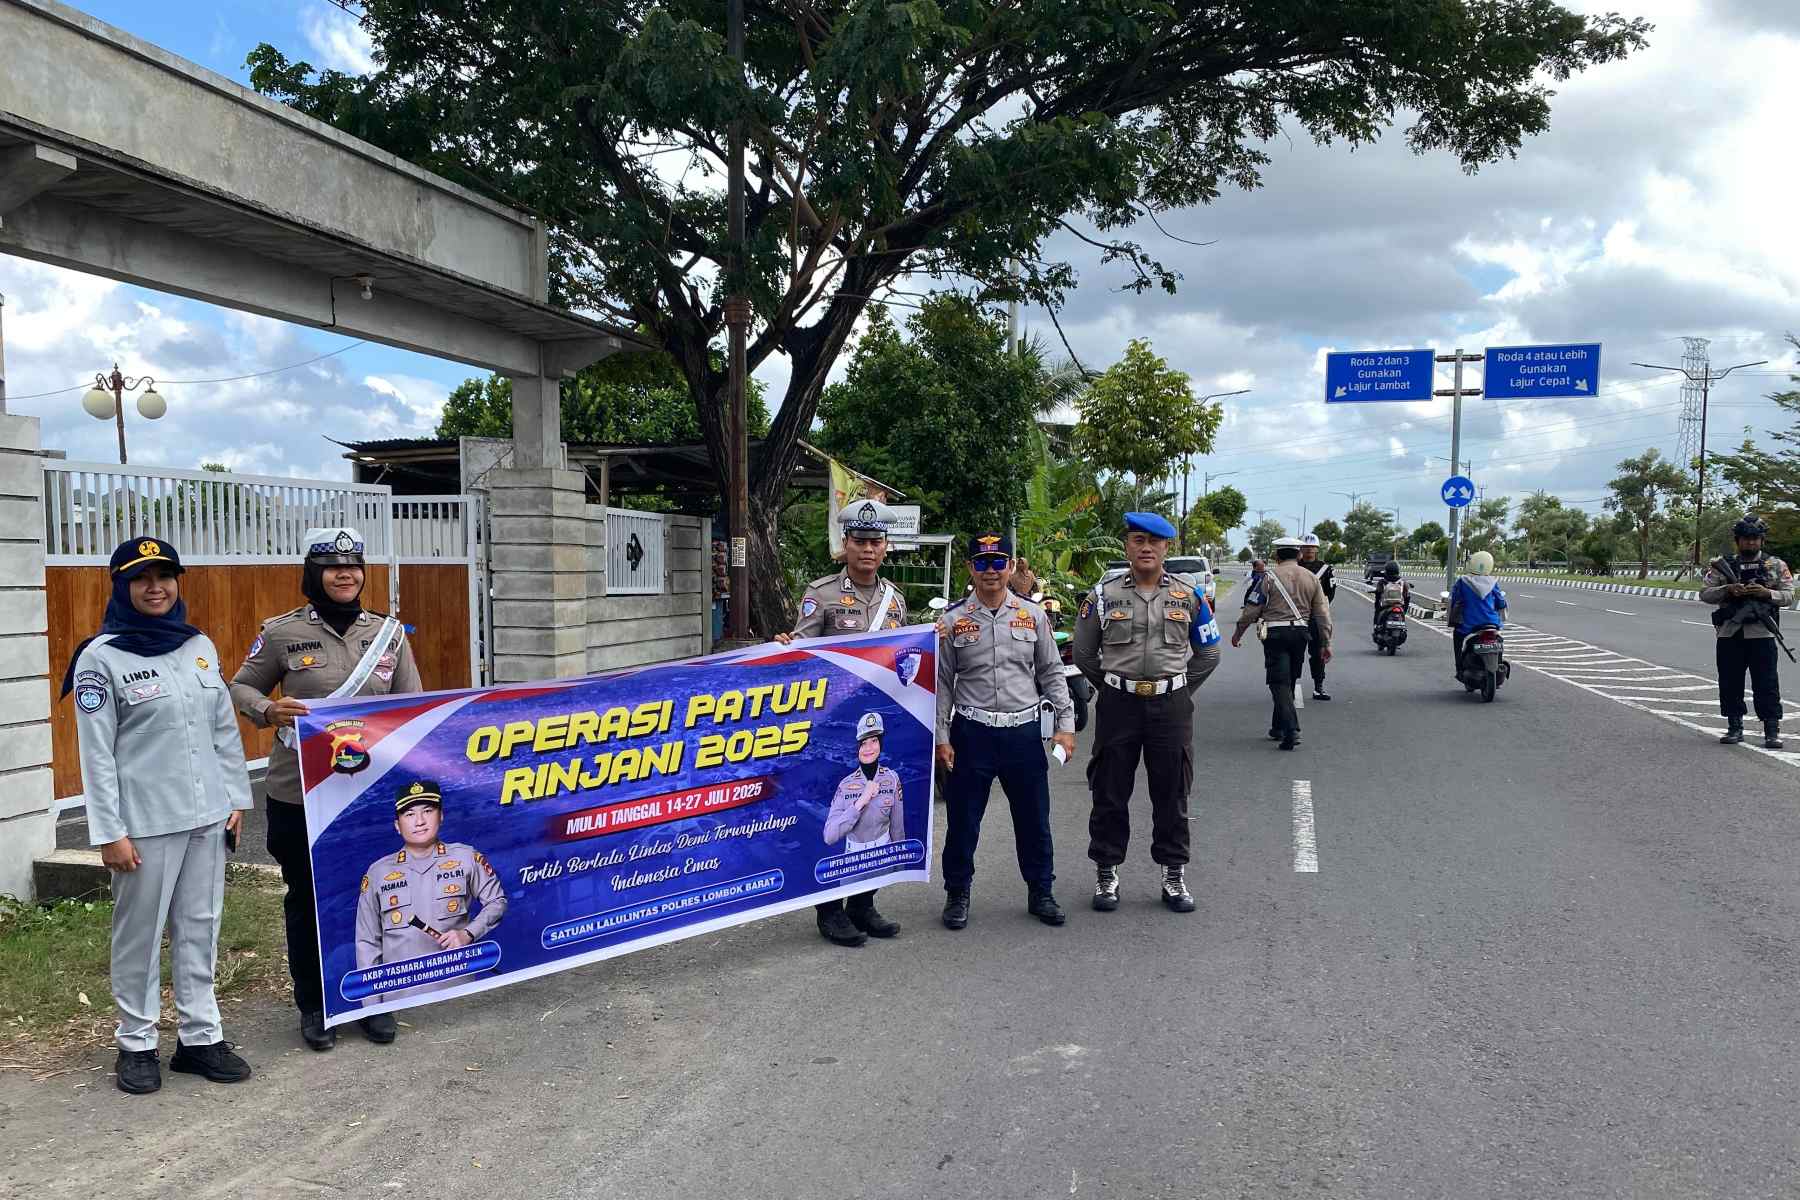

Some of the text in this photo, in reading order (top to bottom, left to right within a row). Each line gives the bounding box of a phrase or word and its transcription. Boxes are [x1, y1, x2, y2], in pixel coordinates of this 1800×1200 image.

[1350, 356, 1410, 367] Roda 2 dan 3
[1497, 350, 1587, 362] Roda 4 atau Lebih
[1358, 369, 1401, 378] Gunakan
[1519, 364, 1567, 374] Gunakan
[1348, 380, 1410, 392] Lajur Lambat
[1510, 376, 1570, 389] Lajur Cepat
[286, 640, 324, 654] MARWA
[122, 669, 160, 684] LINDA
[465, 678, 828, 764] OPERASI PATUH
[499, 720, 812, 805] RINJANI 2025
[566, 782, 763, 836] MULAI TANGGAL 14-27 JULI 2025
[519, 860, 563, 885] Tertib
[628, 839, 674, 863] Lintas
[677, 830, 711, 849] Demi
[714, 814, 798, 841] Terwujudnya
[829, 860, 844, 868] IPTU
[840, 866, 858, 874] LANTAS
[898, 852, 916, 860] BARAT
[436, 869, 464, 881] POLRI
[611, 855, 722, 893] Indonesia Emas
[380, 879, 408, 893] YASMARA
[550, 876, 776, 942] SATUAN LALULINTAS POLRES LOMBOK BARAT
[362, 969, 383, 983] AKBP
[386, 961, 424, 976] YASMARA
[426, 952, 463, 968] HARAHAP
[373, 962, 468, 991] KAPOLRES LOMBOK BARAT
